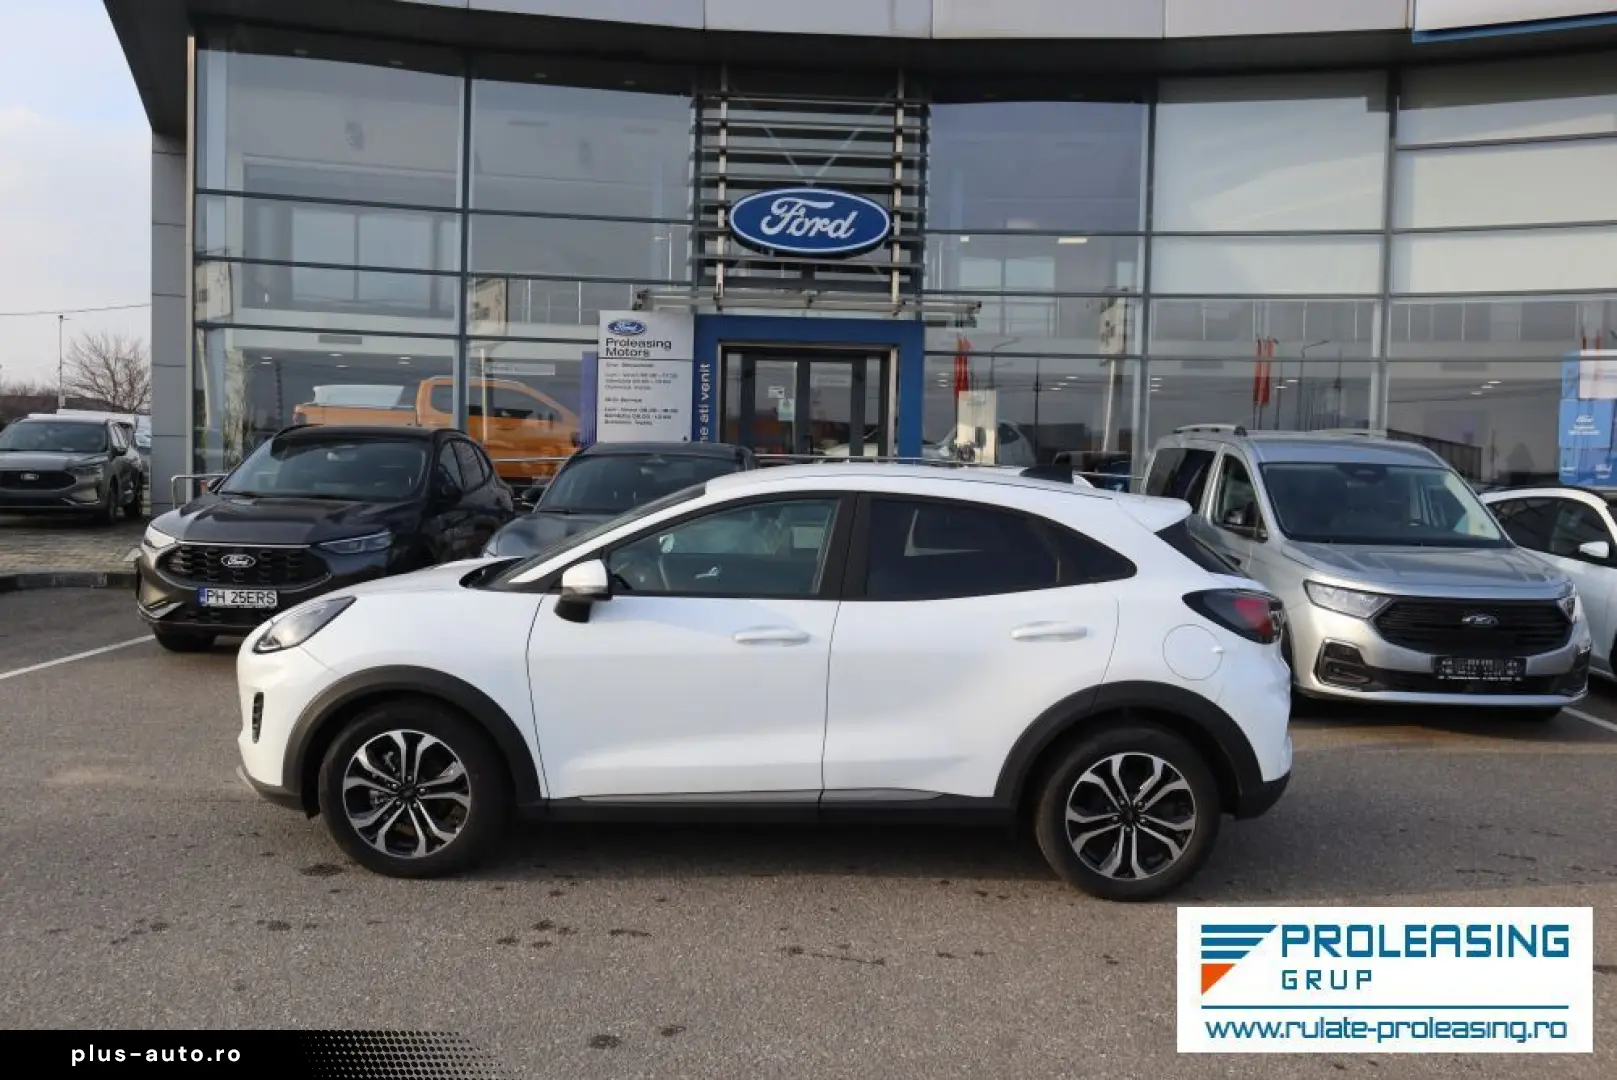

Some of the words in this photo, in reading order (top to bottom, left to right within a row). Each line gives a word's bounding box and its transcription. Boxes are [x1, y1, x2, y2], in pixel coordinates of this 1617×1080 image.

[760, 196, 858, 239] Ford
[606, 337, 672, 350] Proleasing
[605, 347, 650, 357] Motors
[699, 363, 711, 401] venit
[206, 590, 226, 604] PH
[230, 590, 277, 605] 25ERS
